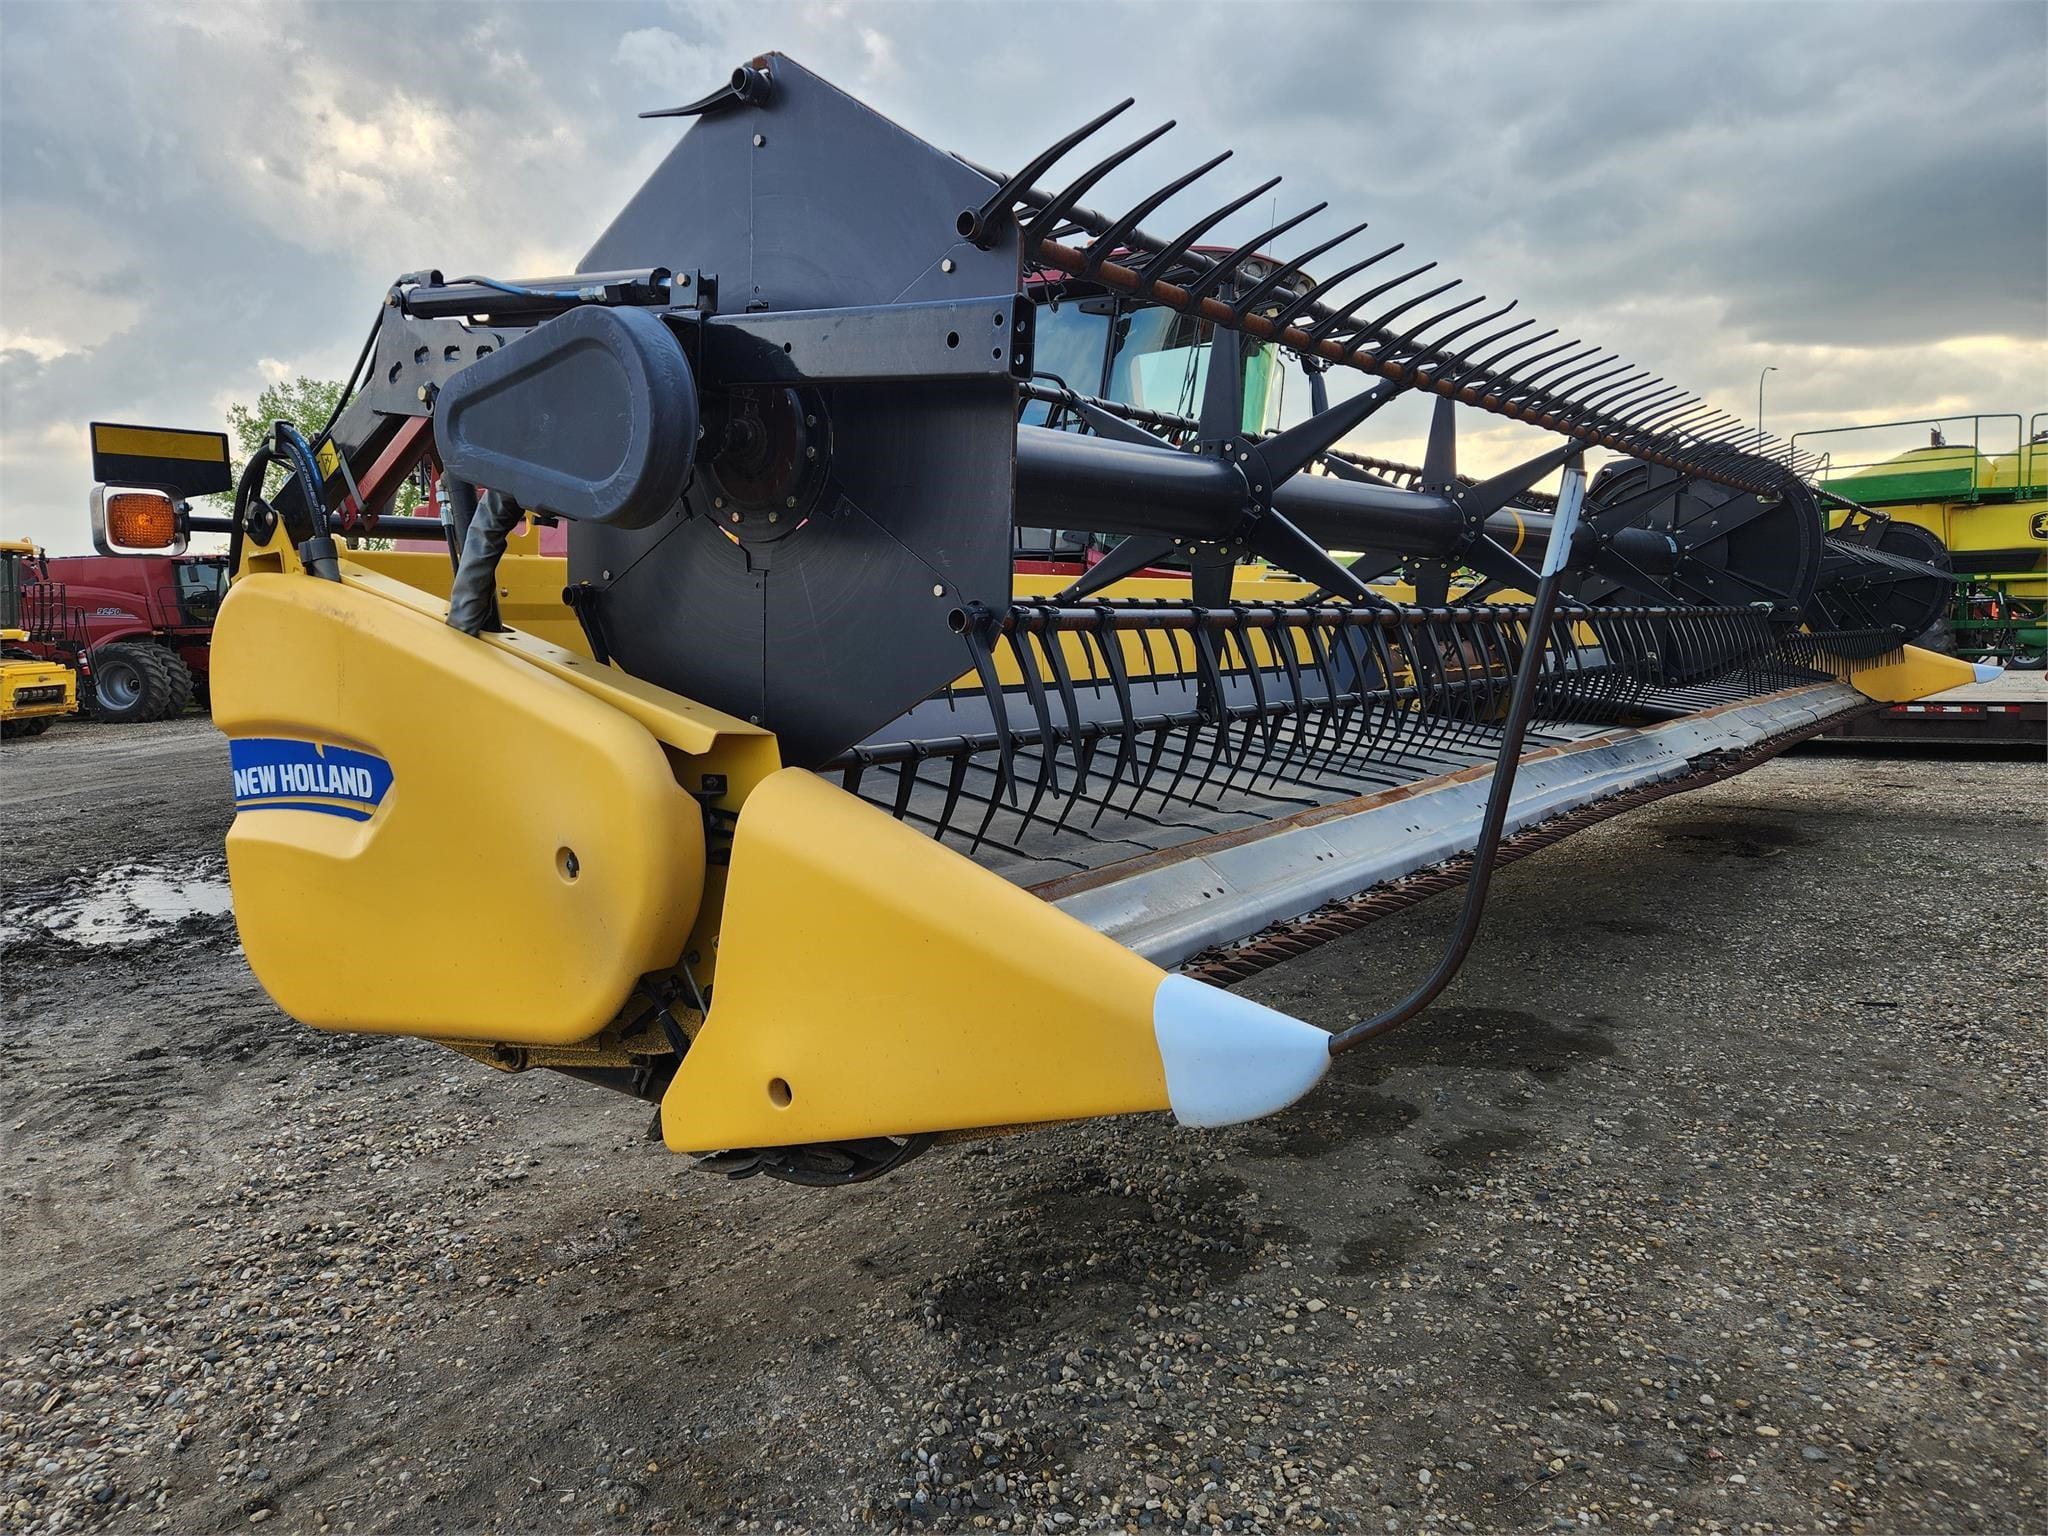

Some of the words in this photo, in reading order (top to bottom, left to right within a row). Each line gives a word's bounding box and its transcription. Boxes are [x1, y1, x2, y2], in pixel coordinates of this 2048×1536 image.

[96, 607, 121, 616] 9250
[233, 765, 276, 797] NEW
[279, 763, 373, 799] HOLLAND
